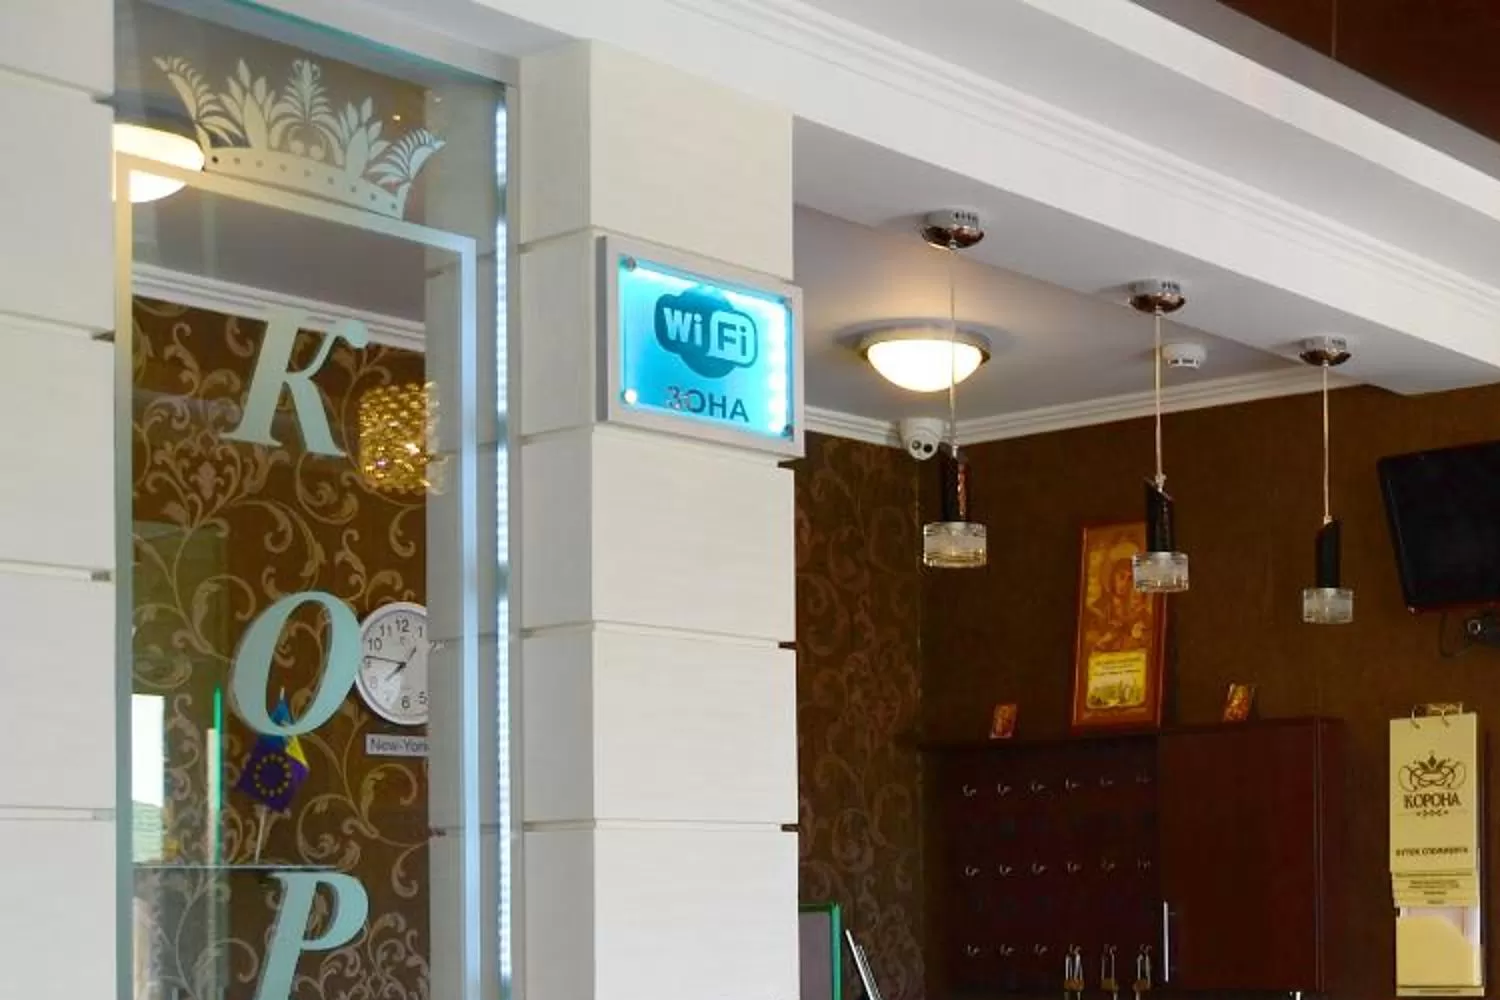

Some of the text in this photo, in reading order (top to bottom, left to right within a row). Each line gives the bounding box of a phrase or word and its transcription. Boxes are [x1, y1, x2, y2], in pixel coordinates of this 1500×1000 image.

[667, 384, 750, 423] ЗОНА
[379, 623, 393, 637] 11
[396, 619, 410, 633] 12
[367, 637, 384, 651] 10
[401, 695, 411, 709] 6
[1403, 791, 1462, 809] КОРОНА
